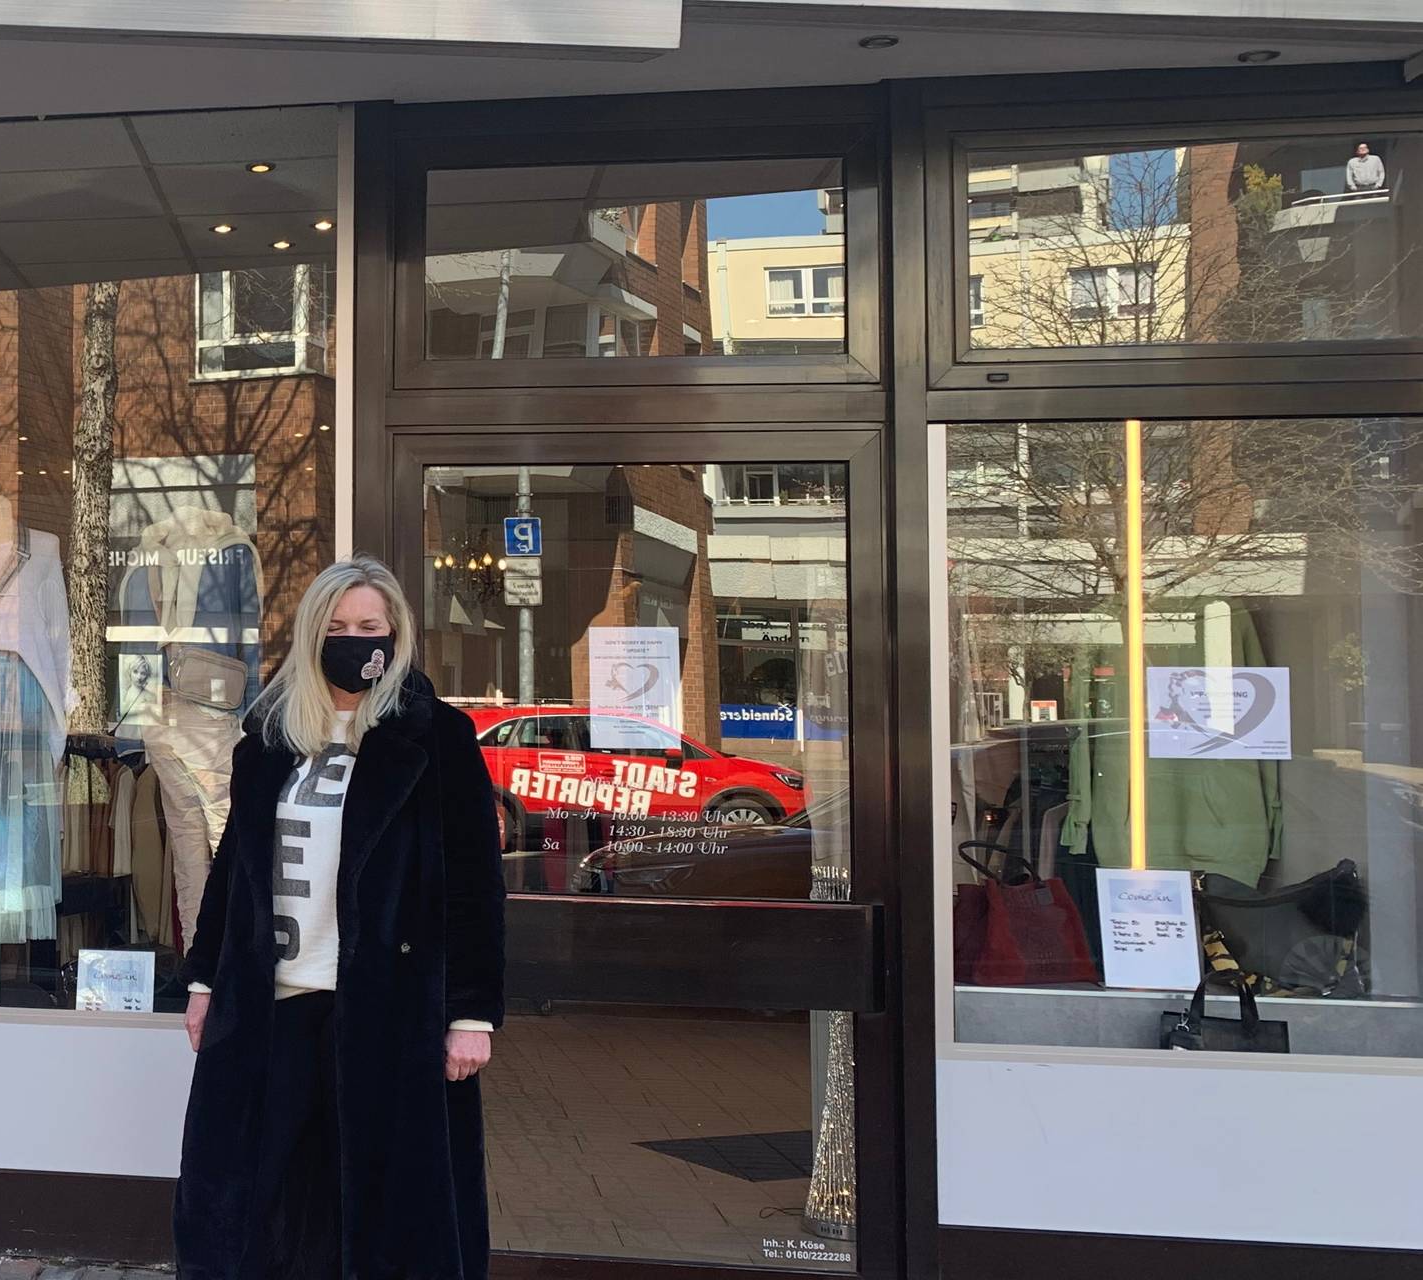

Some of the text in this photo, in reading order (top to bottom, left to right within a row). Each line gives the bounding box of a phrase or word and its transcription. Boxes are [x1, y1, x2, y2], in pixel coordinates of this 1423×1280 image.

[546, 807, 569, 820] Mo
[580, 807, 600, 820] Fr
[661, 811, 698, 822] 13:30
[701, 810, 730, 823] Uhr
[609, 825, 646, 837] 14:30
[660, 826, 696, 838] 18:30
[701, 826, 731, 839] Uhr
[542, 838, 560, 851] Sa
[606, 841, 644, 853] 10:00
[657, 841, 694, 854] 14:00
[697, 842, 729, 855] Uhr
[762, 1238, 825, 1250] Inh.: K. Köse
[763, 1249, 851, 1262] Tel.: 0160/2222288
